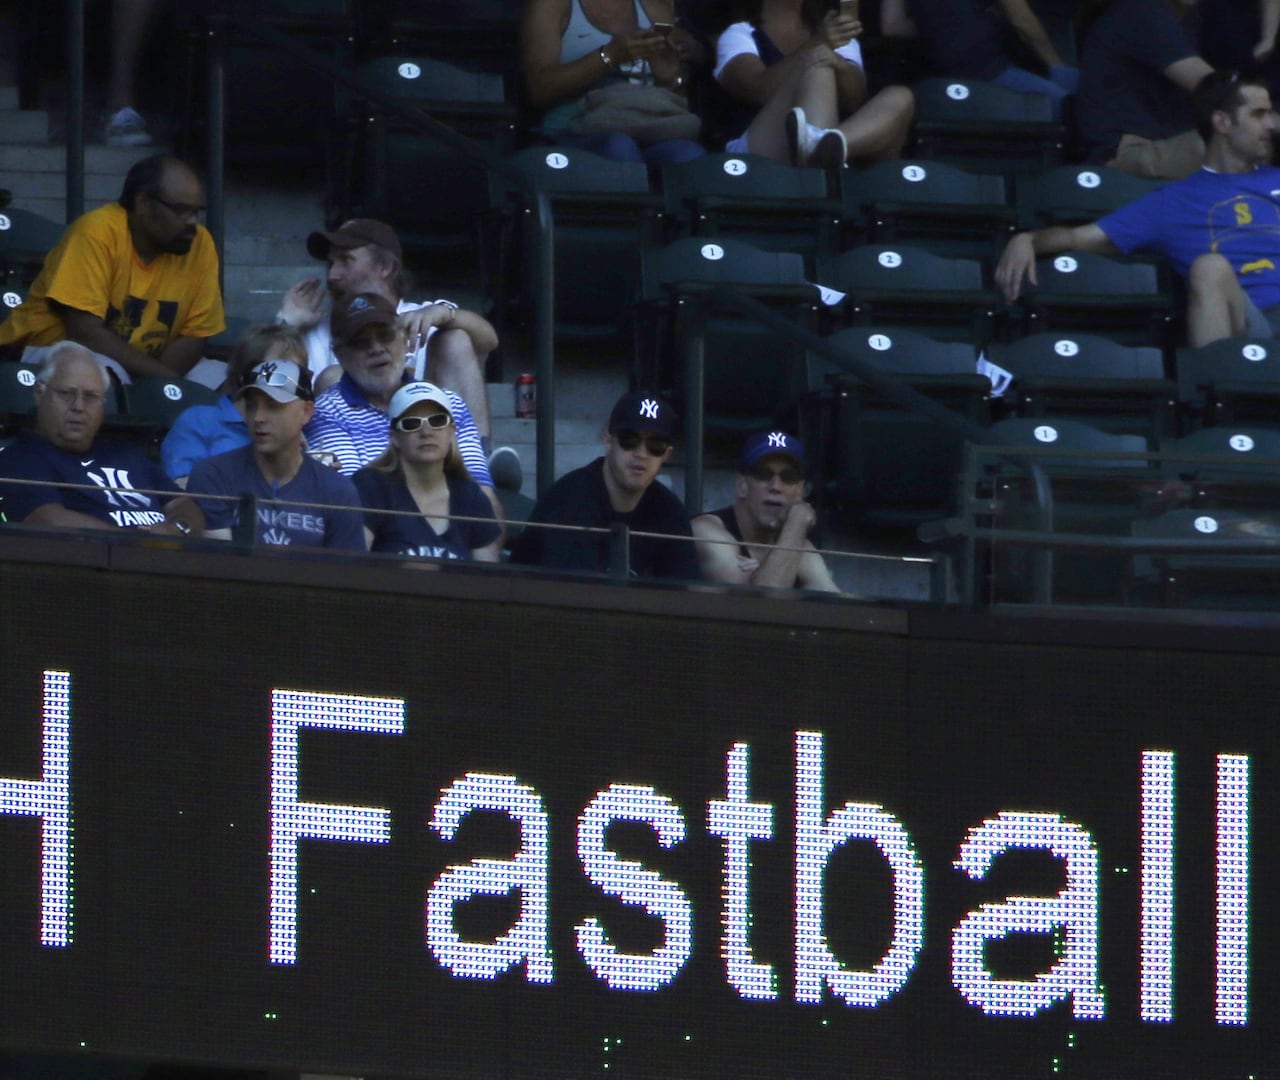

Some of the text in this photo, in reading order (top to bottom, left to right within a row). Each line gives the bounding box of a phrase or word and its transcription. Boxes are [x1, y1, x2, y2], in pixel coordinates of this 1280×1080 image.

[7, 295, 18, 305] 12
[22, 373, 32, 383] 11
[167, 386, 179, 398] 12
[268, 688, 1251, 1027] Fastball
